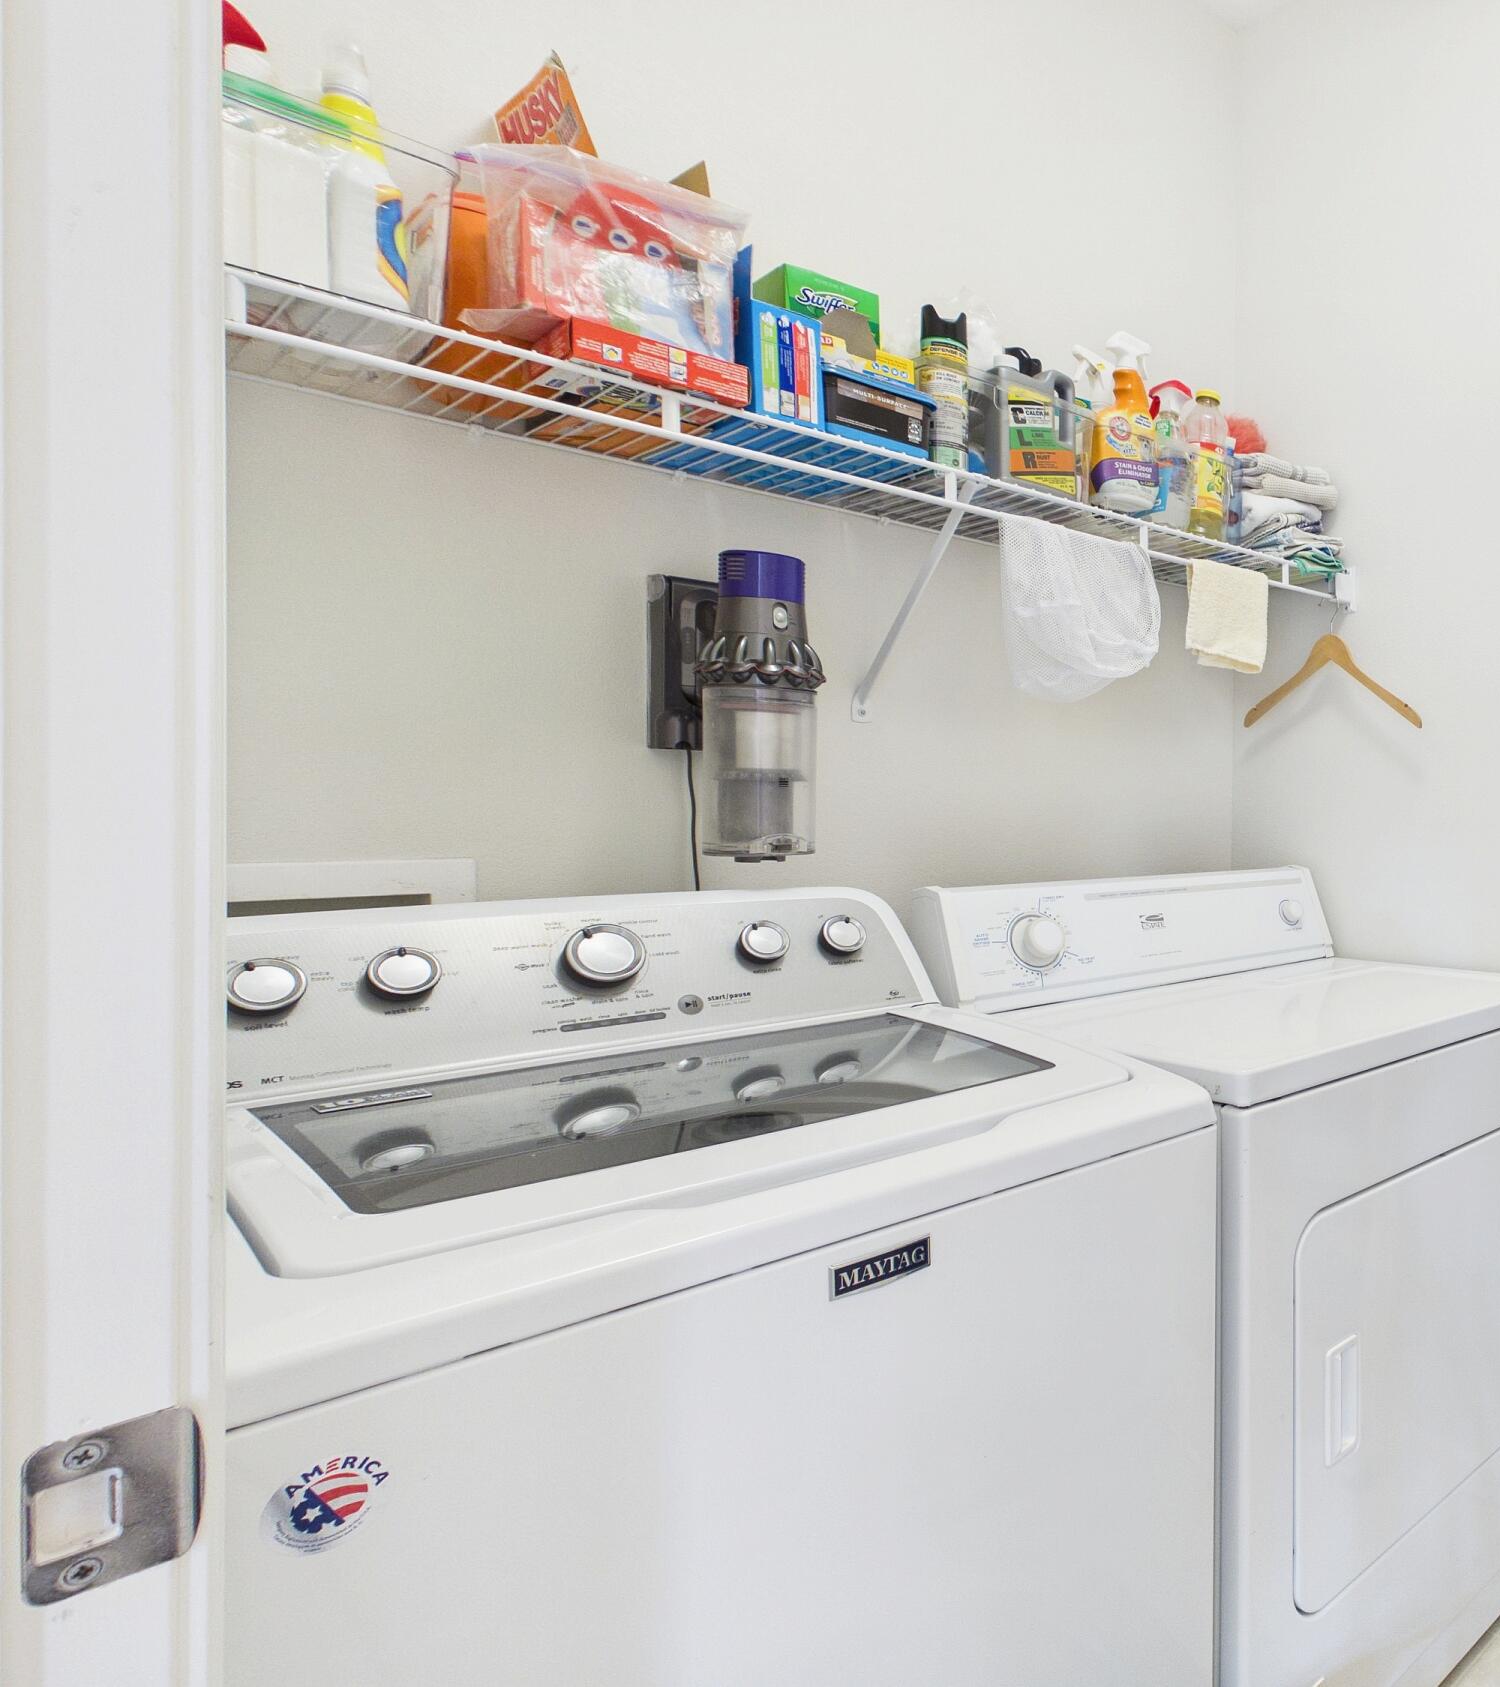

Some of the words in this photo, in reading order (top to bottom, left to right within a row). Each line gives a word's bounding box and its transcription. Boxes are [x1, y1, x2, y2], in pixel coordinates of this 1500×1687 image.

[500, 68, 564, 144] HUSKY
[707, 991, 752, 1002] start/pause
[261, 1075, 285, 1085] MCT
[838, 1245, 925, 1291] MAYTAG
[285, 1455, 390, 1500] AMERICA
